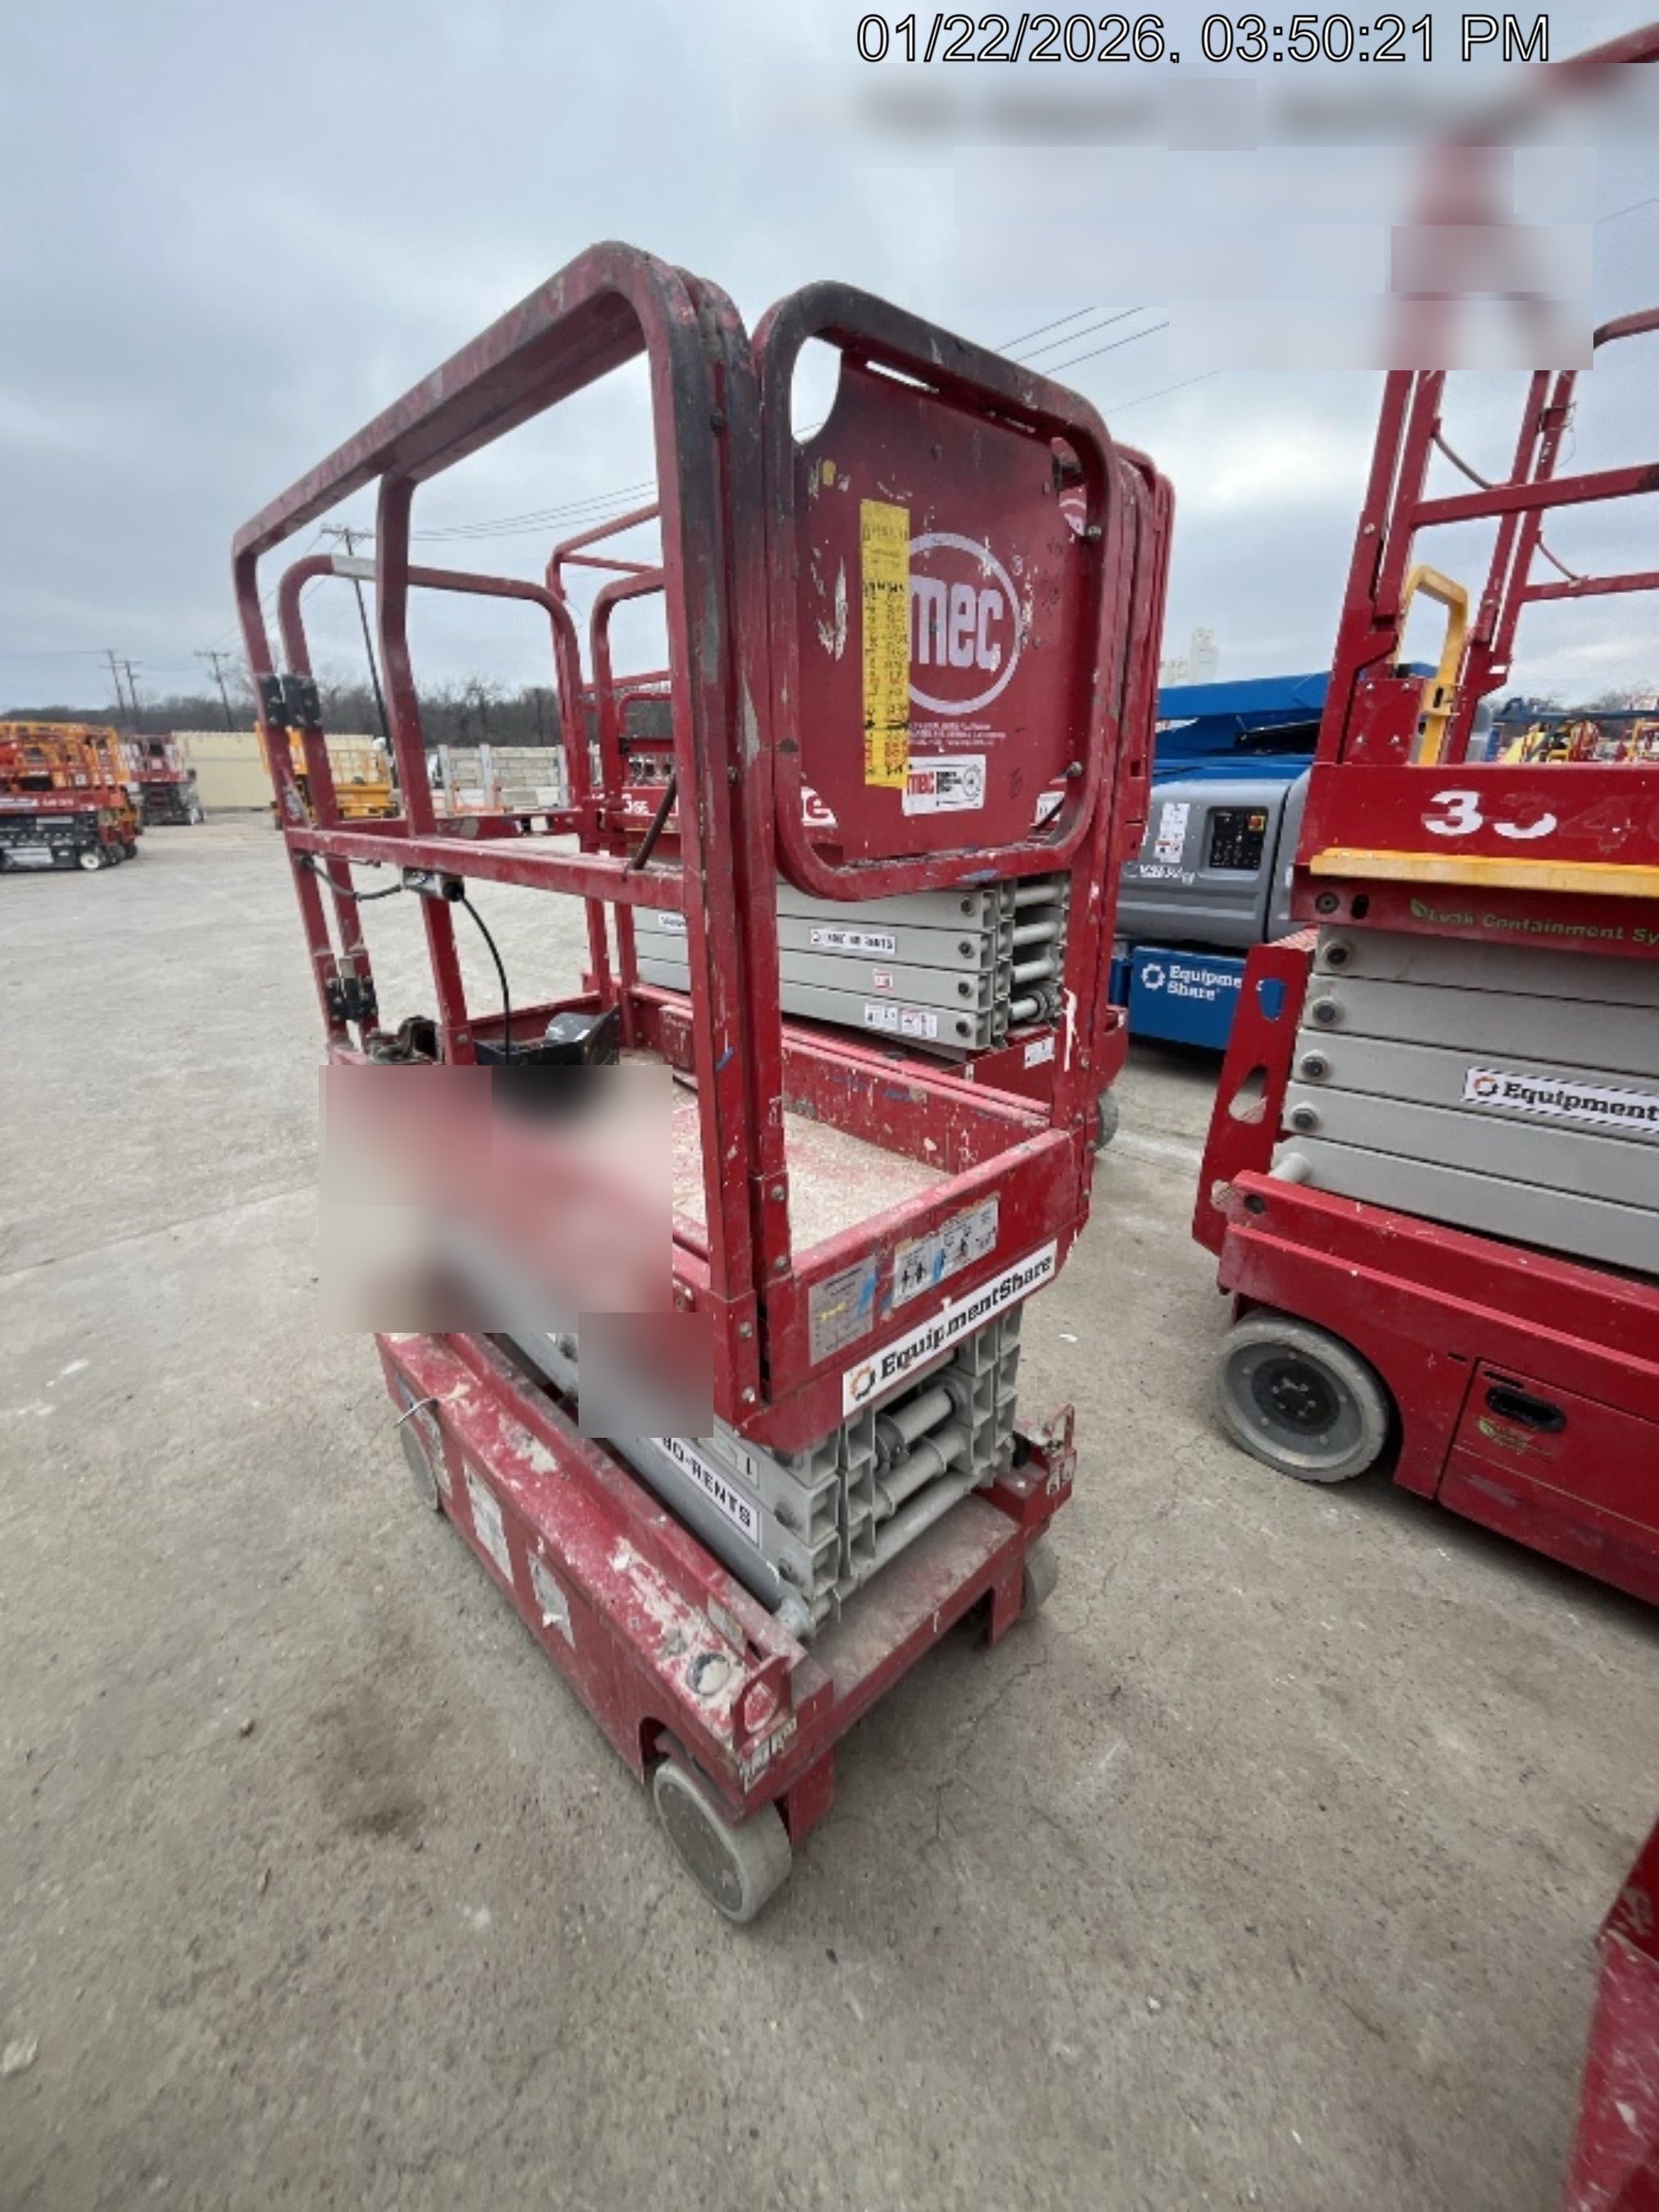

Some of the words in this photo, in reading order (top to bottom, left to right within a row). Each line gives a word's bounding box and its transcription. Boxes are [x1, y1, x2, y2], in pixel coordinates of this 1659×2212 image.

[907, 573, 1004, 670] mec
[1482, 913, 1624, 940] Containment
[881, 1256, 1052, 1380] EquipmentShare
